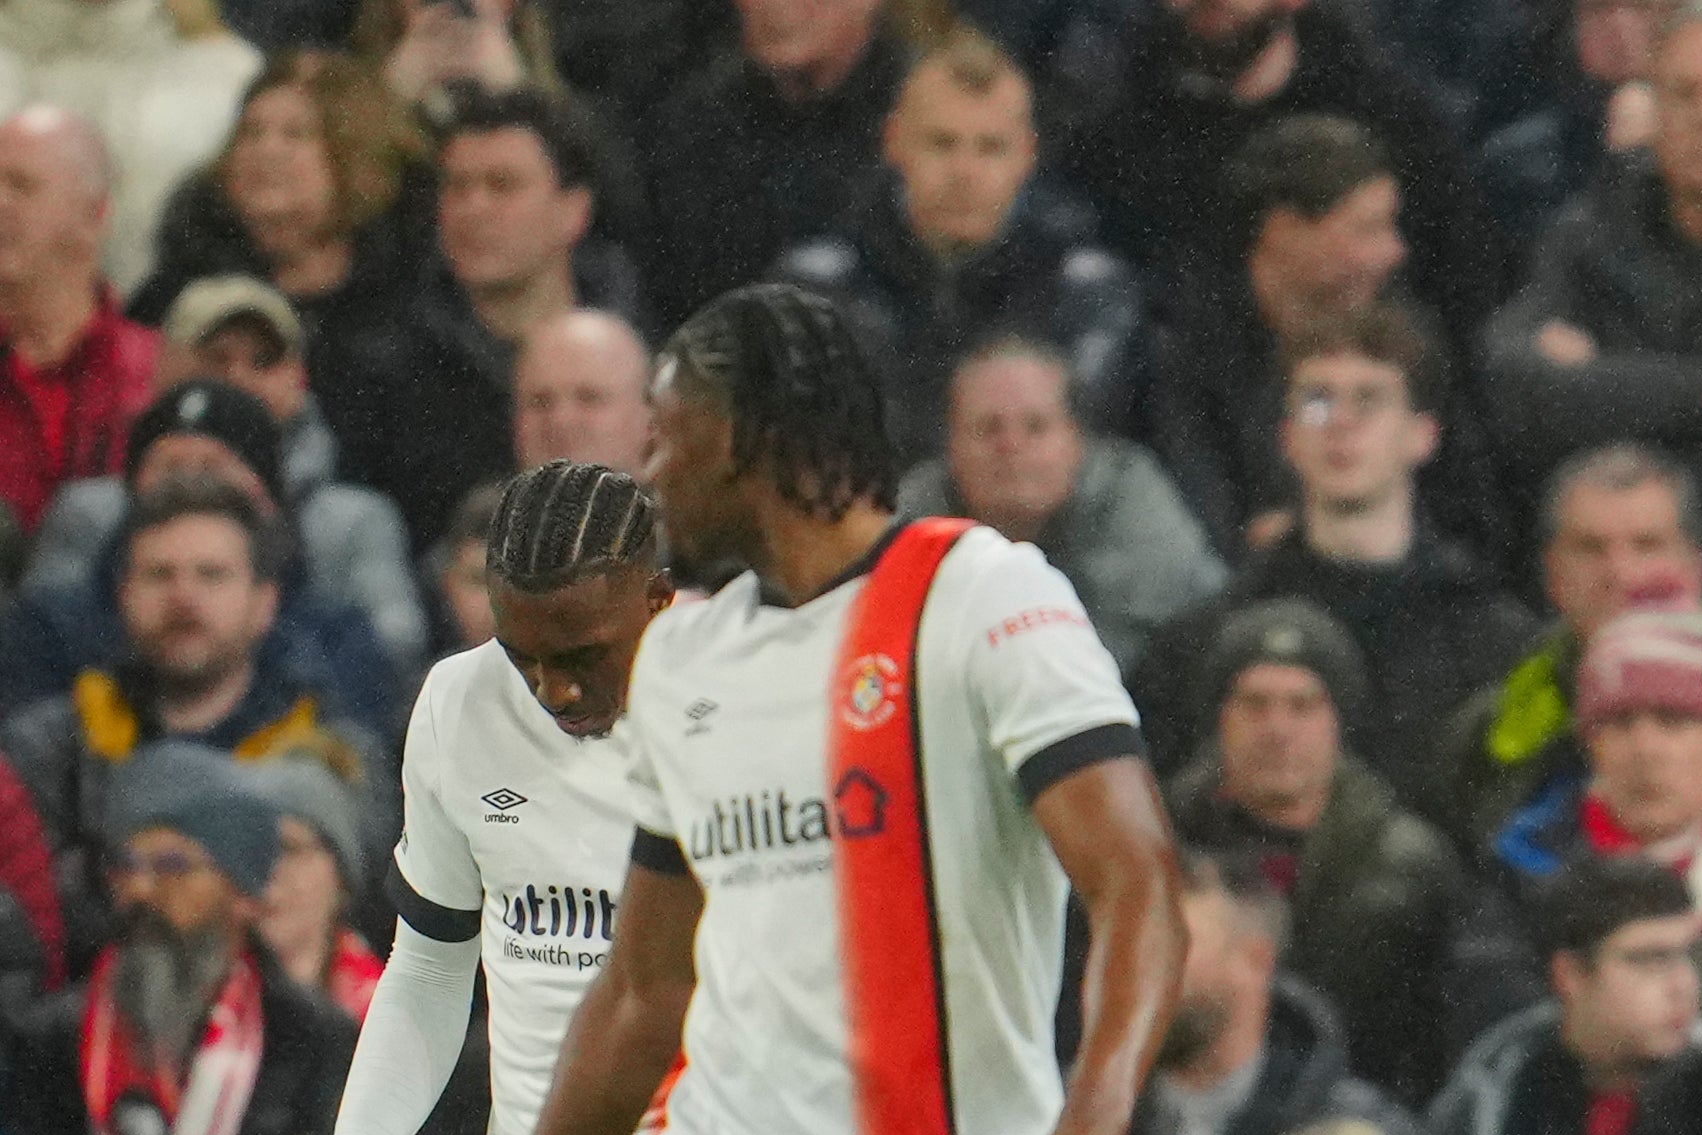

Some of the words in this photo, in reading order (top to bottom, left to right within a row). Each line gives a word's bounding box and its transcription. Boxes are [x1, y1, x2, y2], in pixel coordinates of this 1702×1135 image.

[484, 813, 520, 824] umbro
[692, 788, 831, 860] utilita
[503, 934, 524, 960] life
[526, 943, 571, 966] with
